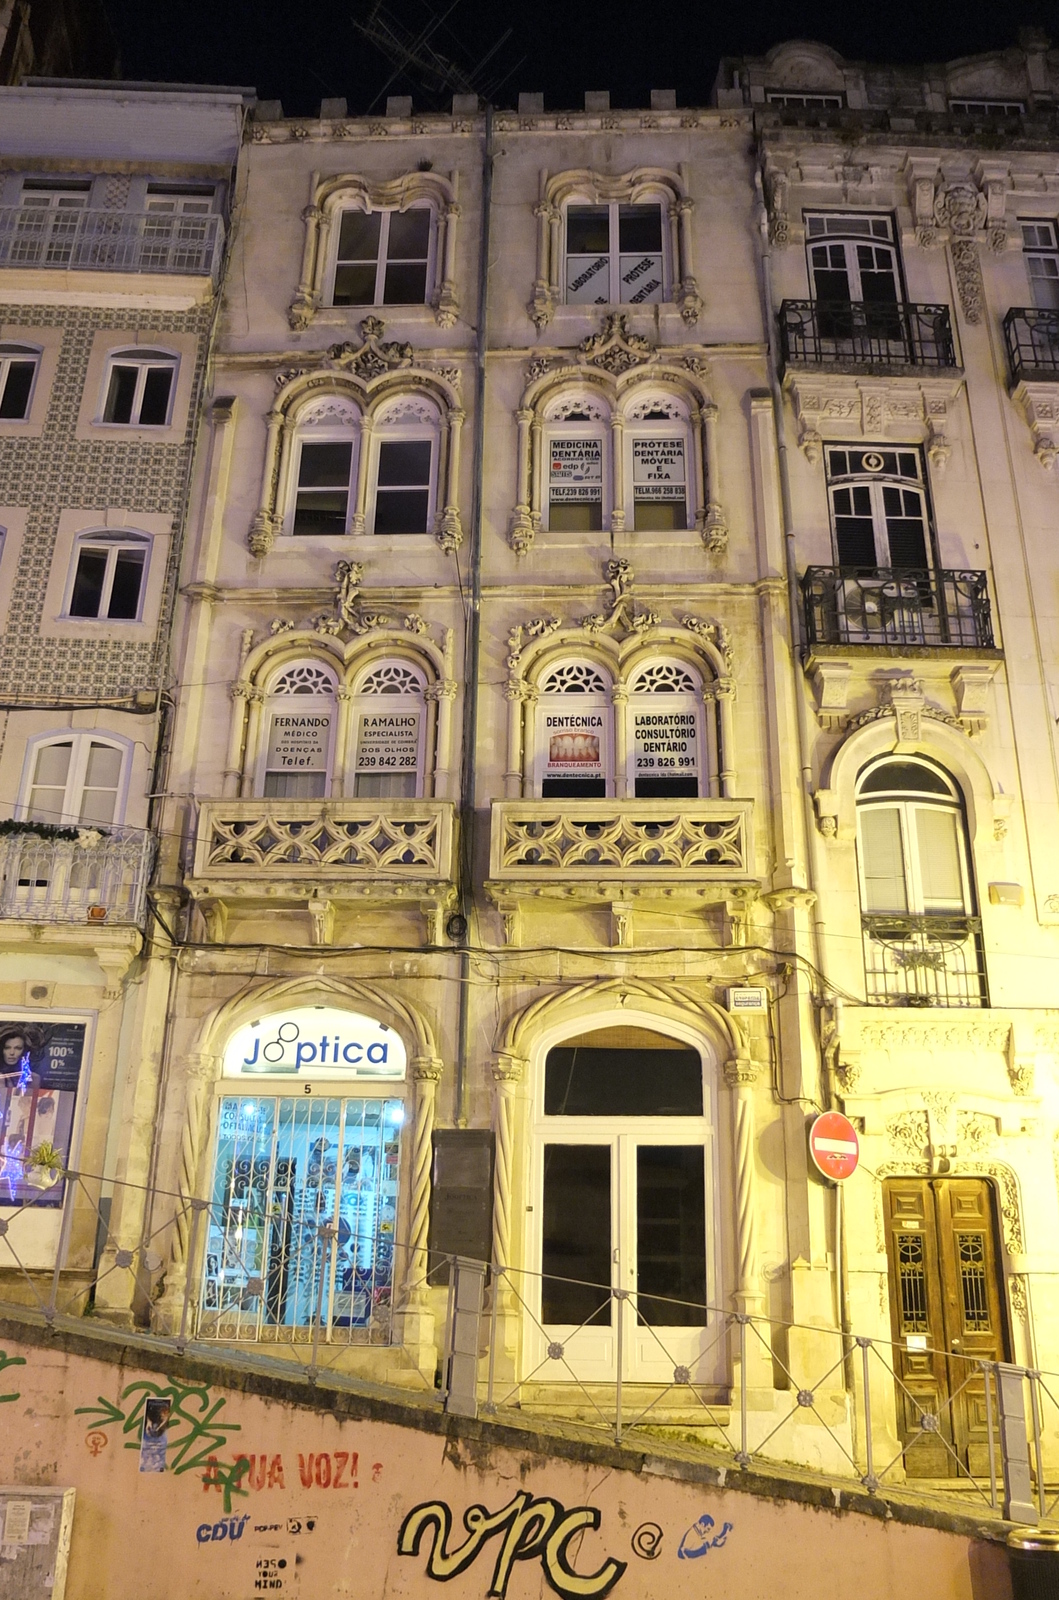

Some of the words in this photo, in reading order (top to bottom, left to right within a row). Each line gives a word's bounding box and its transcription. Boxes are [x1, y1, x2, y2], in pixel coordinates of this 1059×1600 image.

[568, 257, 609, 292] LABORATÓRIO
[622, 258, 655, 285] PRÓTESE
[629, 279, 662, 304] DENTÁRIA
[552, 441, 598, 449] MEDICINA
[634, 440, 682, 448] PRÓTESE
[552, 448, 601, 458] DENTÁRIA
[634, 449, 683, 457] DENTÁRIA
[641, 457, 676, 465] MÓVEL
[590, 488, 600, 496] 991
[274, 717, 330, 727] FERNANDO
[363, 717, 416, 727] RAMALHO
[546, 714, 603, 727] DENTÉCNICA
[635, 713, 695, 726] LABORATÓRIO
[635, 727, 696, 739] CONSULTÓRIO
[643, 740, 687, 752] DENTÁRIO
[281, 756, 314, 765] Telef.
[358, 756, 376, 766] 239
[378, 756, 397, 766] 842
[399, 756, 417, 766] 282
[636, 758, 655, 767] 239
[657, 757, 675, 767] 826
[678, 757, 695, 766] 991
[48, 1046, 75, 1057] 100%
[50, 1058, 65, 1069] 0%
[304, 1084, 312, 1094] 5
[298, 1451, 359, 1490] VOZ!
[196, 1521, 245, 1544] CDU
[254, 1579, 283, 1590] MIND
